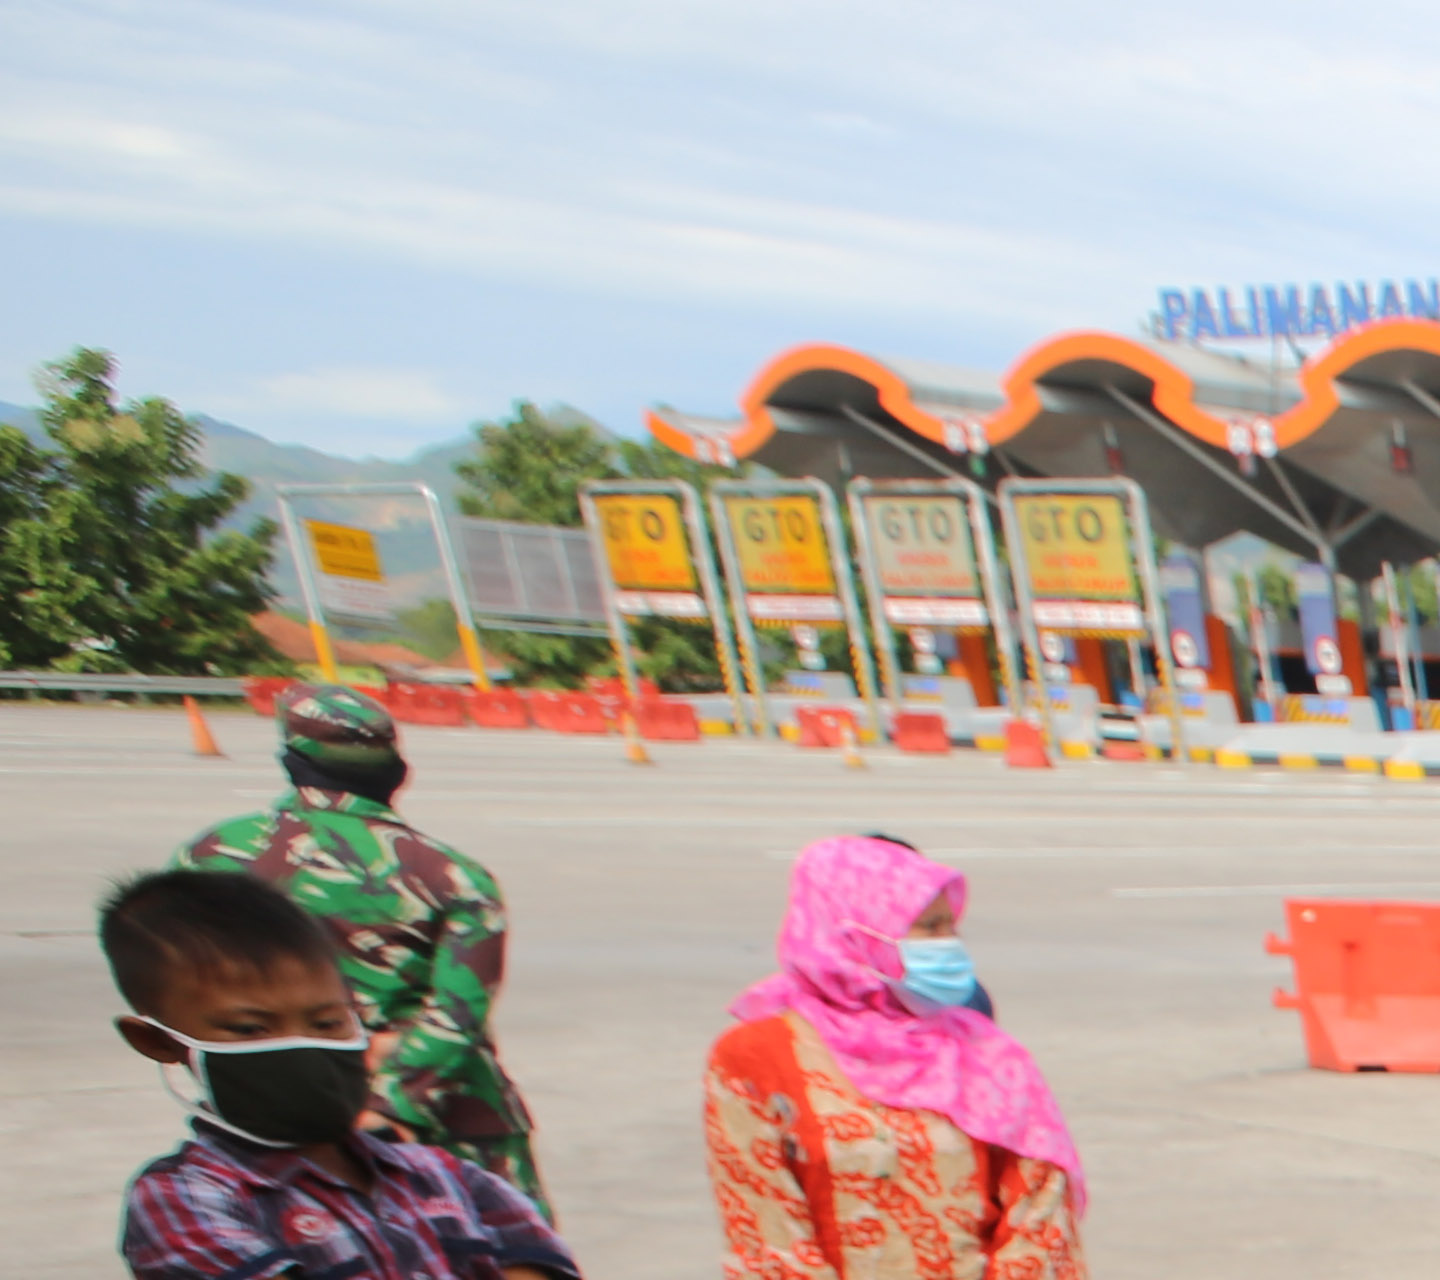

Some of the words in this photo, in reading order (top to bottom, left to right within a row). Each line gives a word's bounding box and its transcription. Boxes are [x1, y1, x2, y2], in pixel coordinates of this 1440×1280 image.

[1158, 278, 1440, 342] PALIMANAN
[880, 505, 950, 541] GTO
[1028, 505, 1102, 541] GTO
